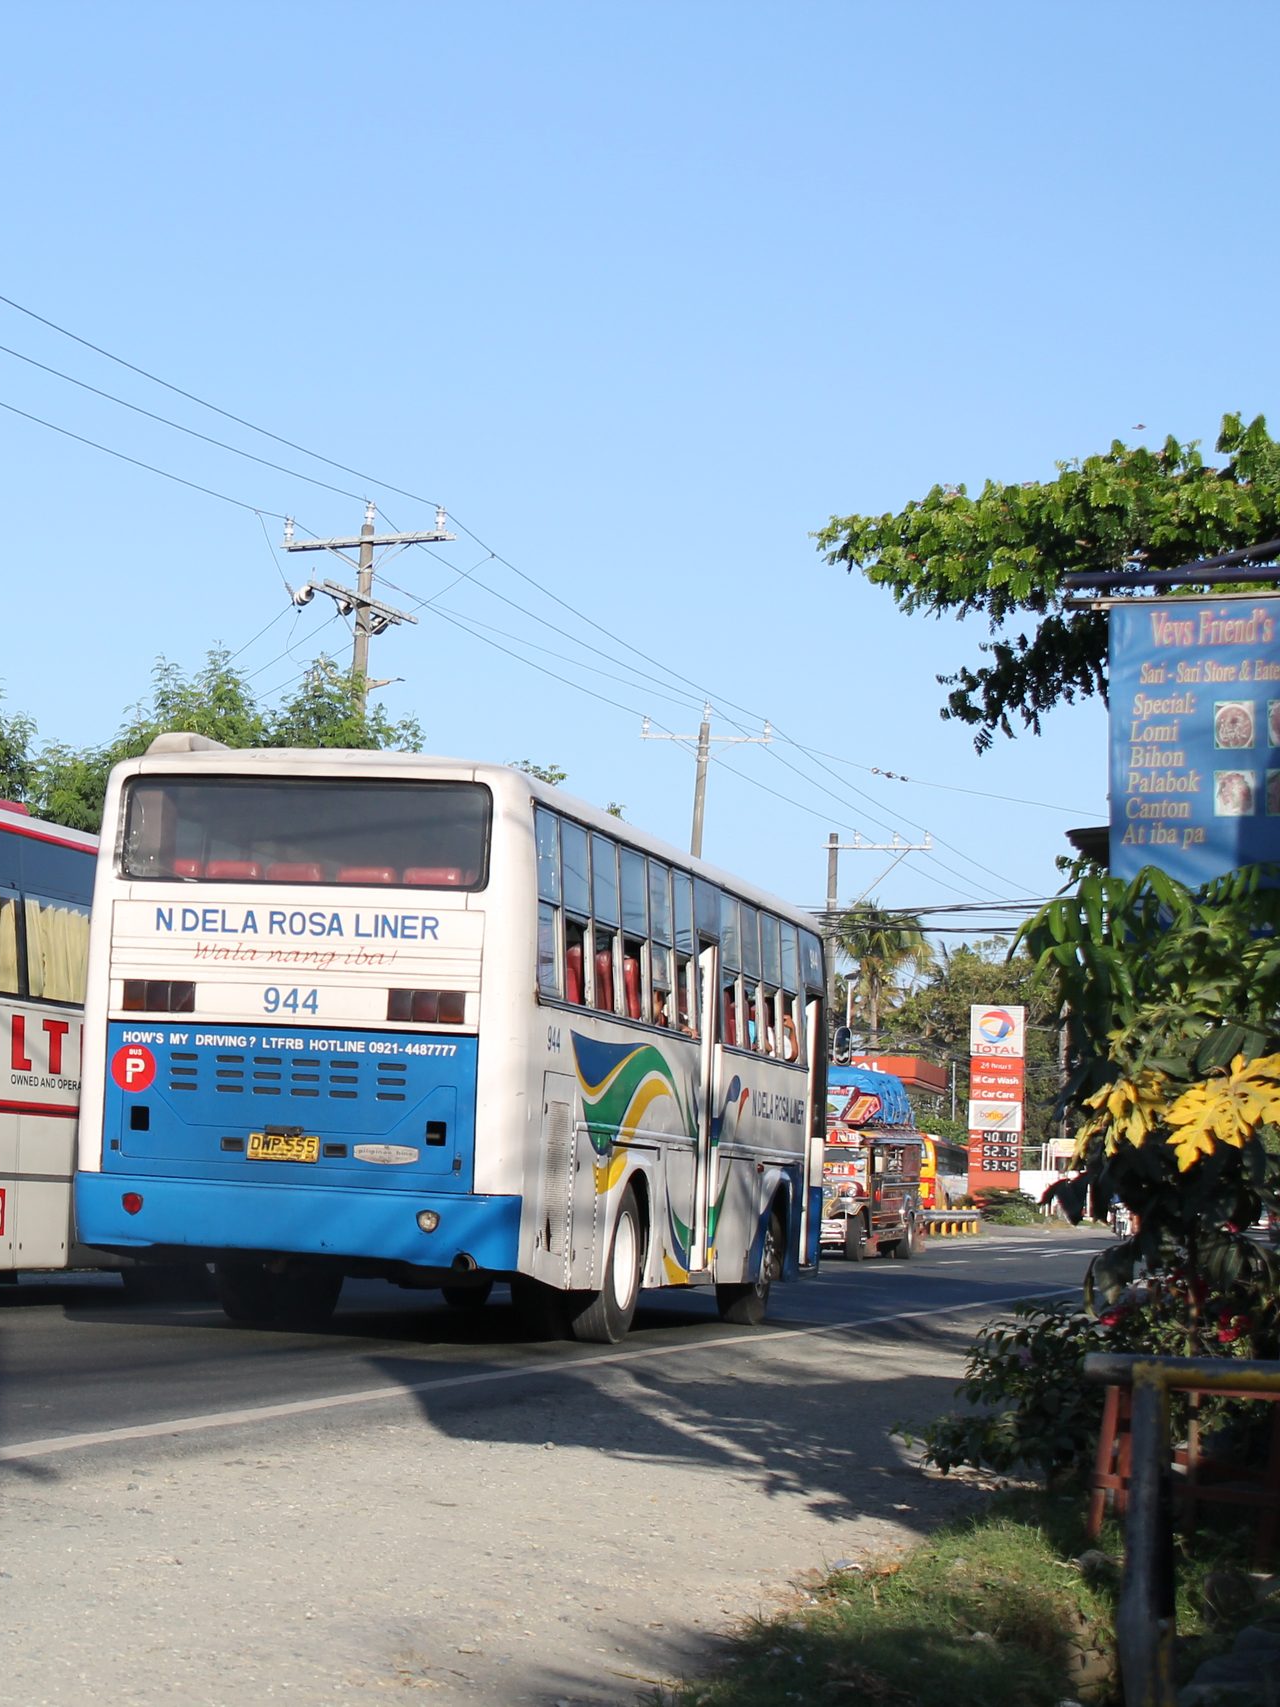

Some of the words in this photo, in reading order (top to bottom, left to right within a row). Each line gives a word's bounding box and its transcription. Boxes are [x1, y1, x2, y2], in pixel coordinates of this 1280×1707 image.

[1140, 662, 1166, 684] Sari
[1176, 660, 1201, 683] Sari
[1204, 660, 1236, 682] Store
[1239, 660, 1250, 681] &
[1133, 693, 1196, 720] Special:
[1129, 719, 1179, 742] Lomi
[1129, 746, 1185, 768] Bihon
[1126, 770, 1201, 794] Palabok
[1125, 797, 1190, 820] Canton
[1121, 823, 1146, 845] At
[1150, 822, 1177, 844] iba
[1182, 826, 1205, 850] pa
[181, 908, 258, 934] DELA
[269, 910, 344, 937] ROSA
[354, 913, 439, 940] LINER
[194, 941, 257, 960] Wala
[266, 949, 337, 970] nang
[263, 986, 319, 1015] 944
[122, 1031, 164, 1044] HOW'S
[170, 1034, 189, 1045] MY
[262, 1036, 304, 1049] LTFRB
[309, 1039, 366, 1053] HOTLINE
[547, 1025, 561, 1053] 944
[129, 1048, 142, 1056] BUS
[11, 1074, 39, 1086] OWNED
[40, 1077, 56, 1088] AND
[125, 1058, 145, 1083] P
[981, 1076, 996, 1084] Car
[997, 1076, 1019, 1085] Wash
[981, 1090, 995, 1098] Car
[996, 1091, 1015, 1099] Care
[983, 1131, 1018, 1143] 40.10
[983, 1145, 1018, 1157] 52.75
[982, 1159, 1017, 1172] 53.45
